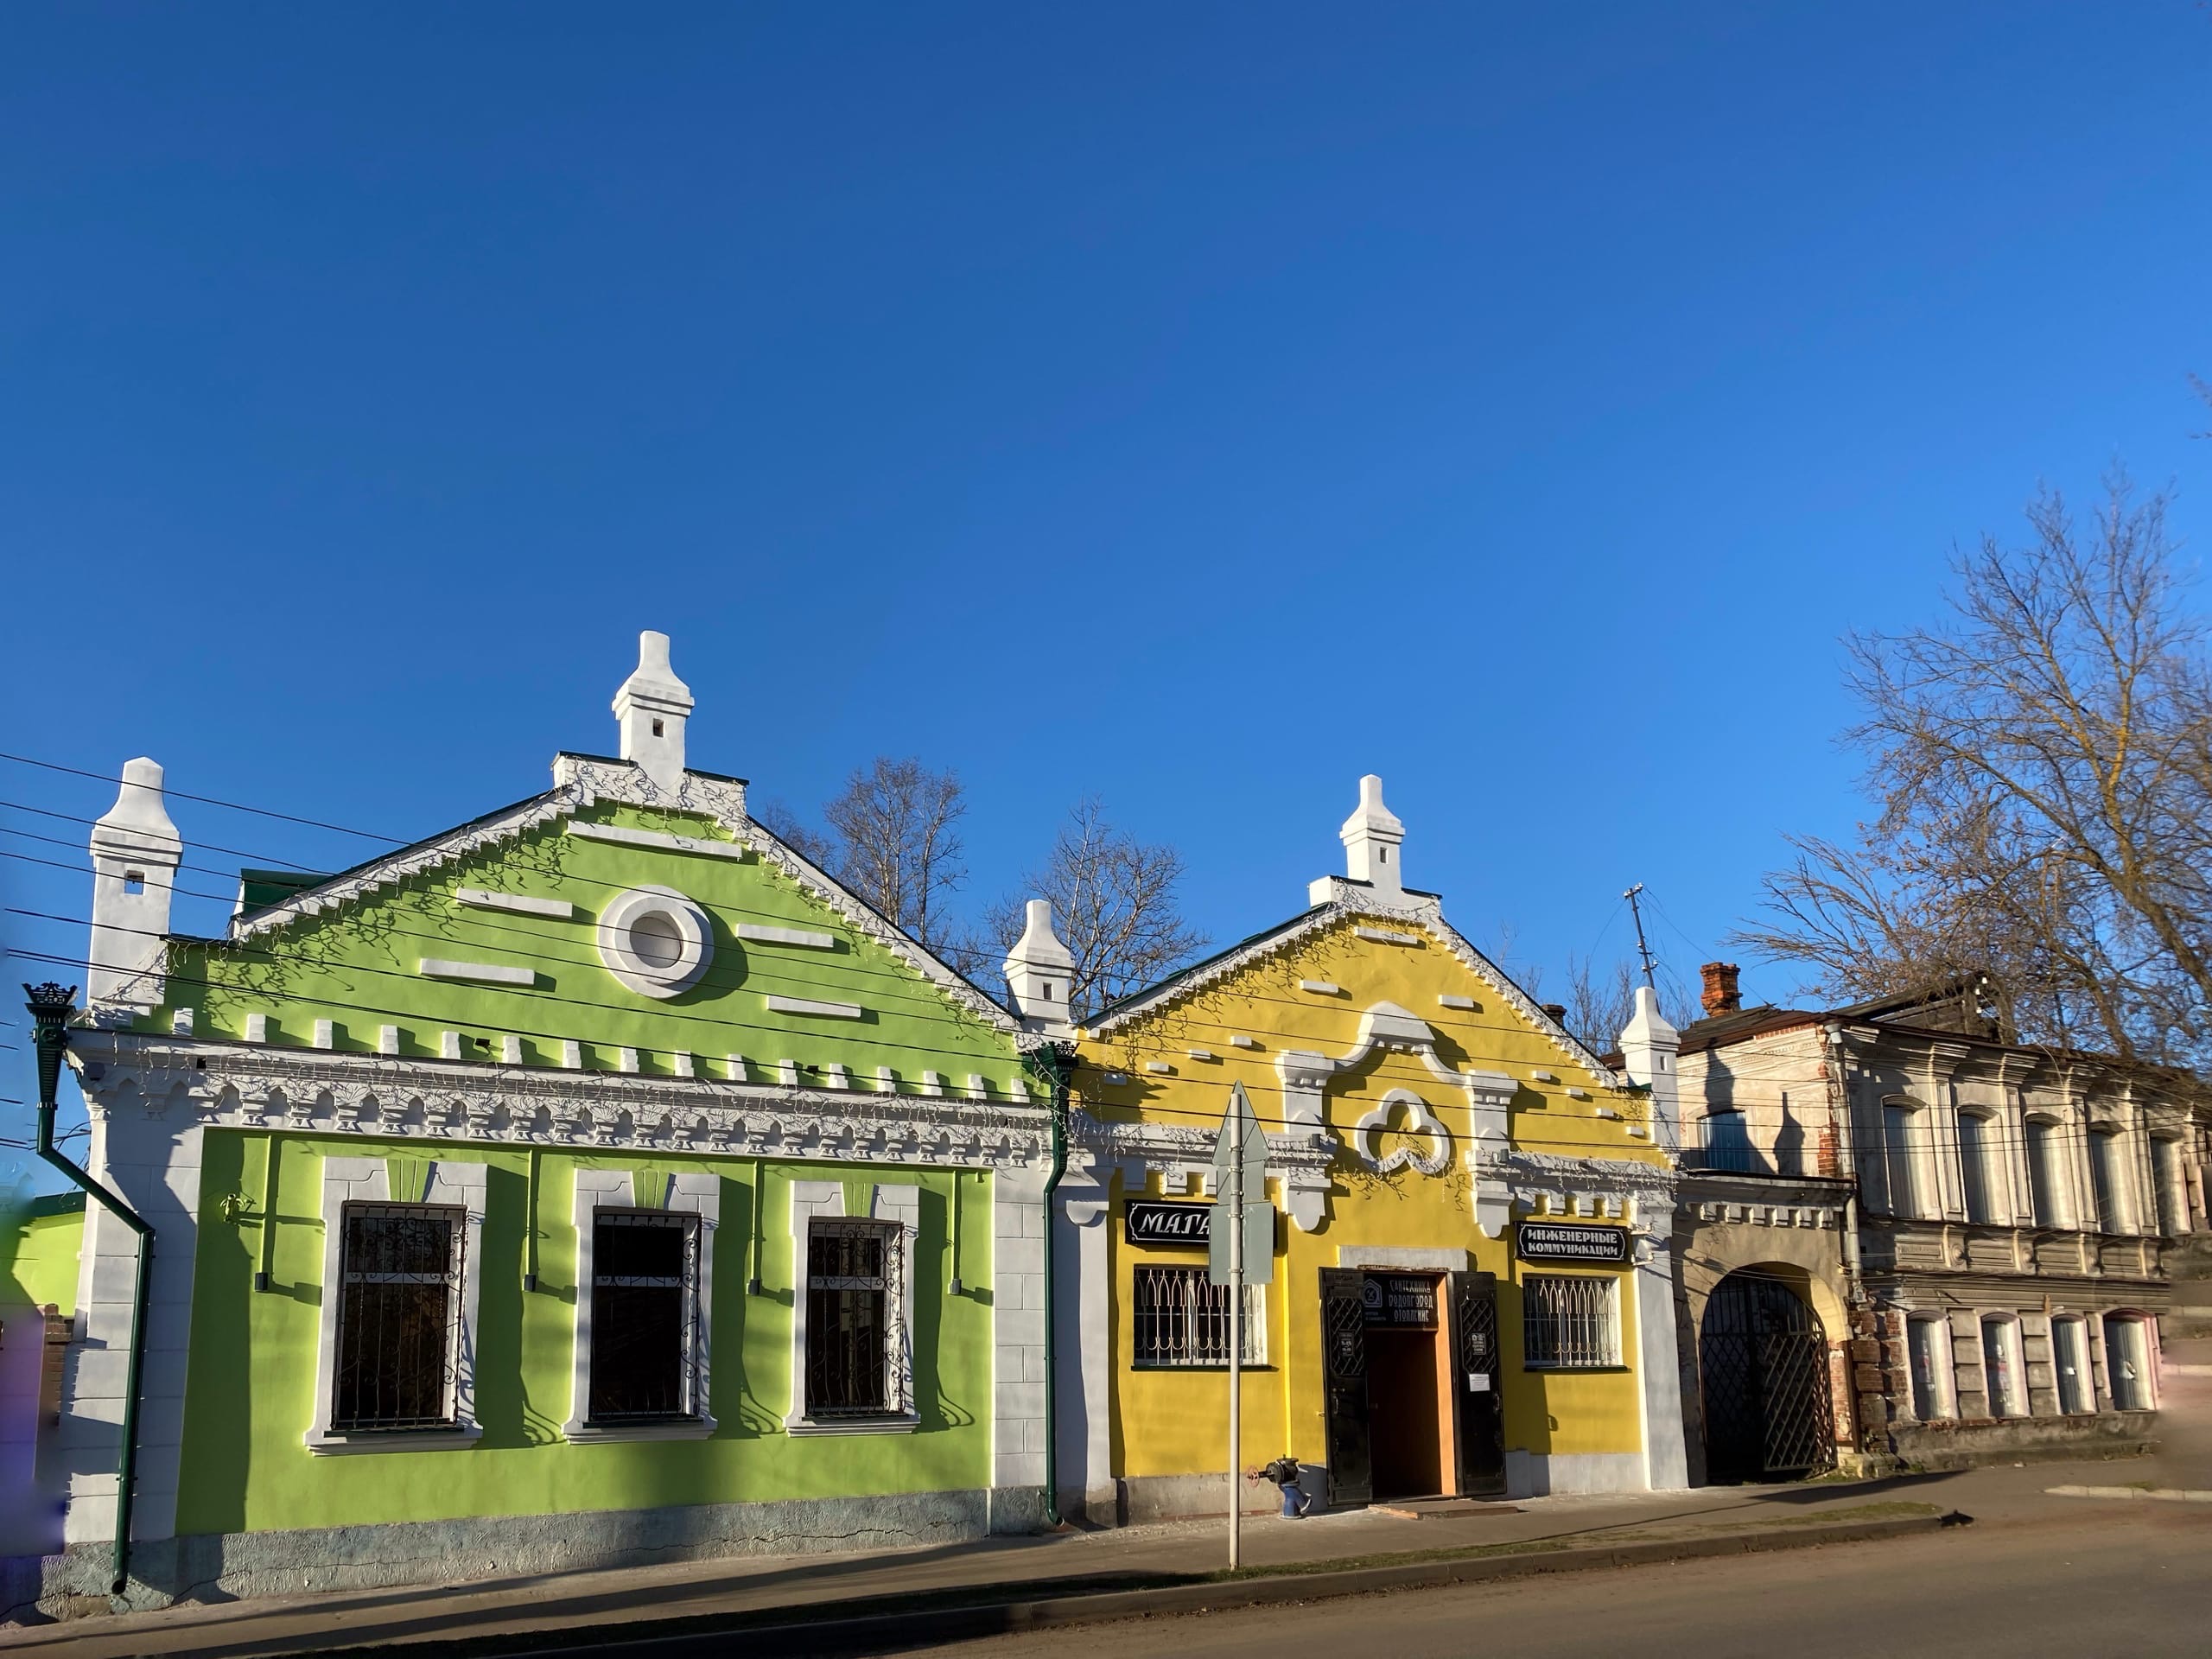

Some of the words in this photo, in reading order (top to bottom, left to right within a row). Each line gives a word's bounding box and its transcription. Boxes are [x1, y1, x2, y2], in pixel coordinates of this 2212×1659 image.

[1138, 1212, 1210, 1235] МАГА
[1528, 1229, 1618, 1243] ИНЖЕНЕРНЫЕ
[1528, 1243, 1618, 1256] КОММУНИКАЦИИ
[1389, 1280, 1431, 1294] САНТЕХНИКА
[1394, 1309, 1430, 1322] ОТОПЛЕНИЕ
